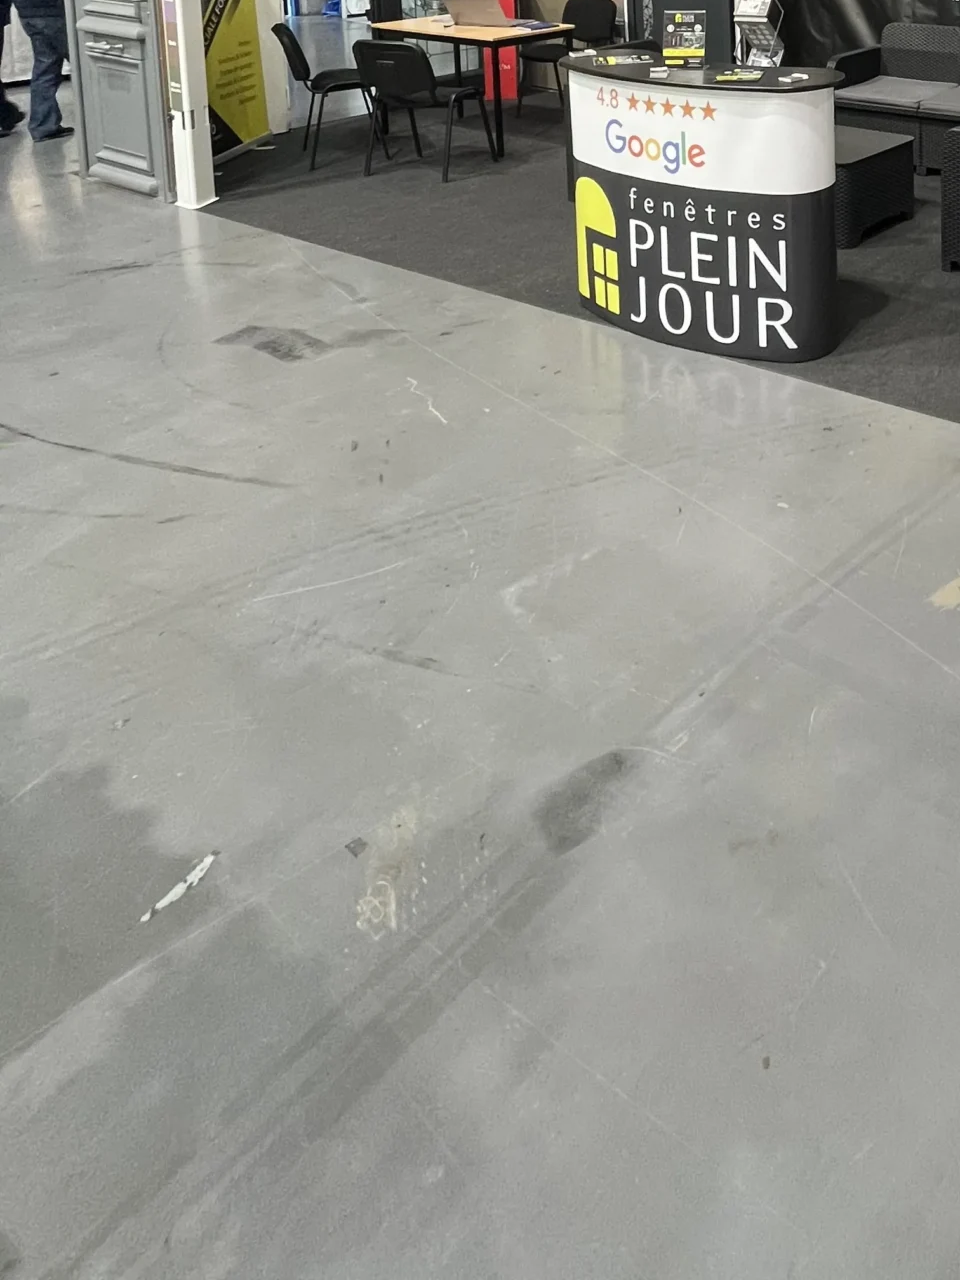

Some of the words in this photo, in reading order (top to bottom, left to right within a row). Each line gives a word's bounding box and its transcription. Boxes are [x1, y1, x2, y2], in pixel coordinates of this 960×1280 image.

[597, 87, 618, 109] 4.8
[605, 119, 706, 174] Google
[629, 187, 786, 230] fenêtres
[629, 218, 787, 292] PLEIN
[630, 276, 798, 349] JOUR
